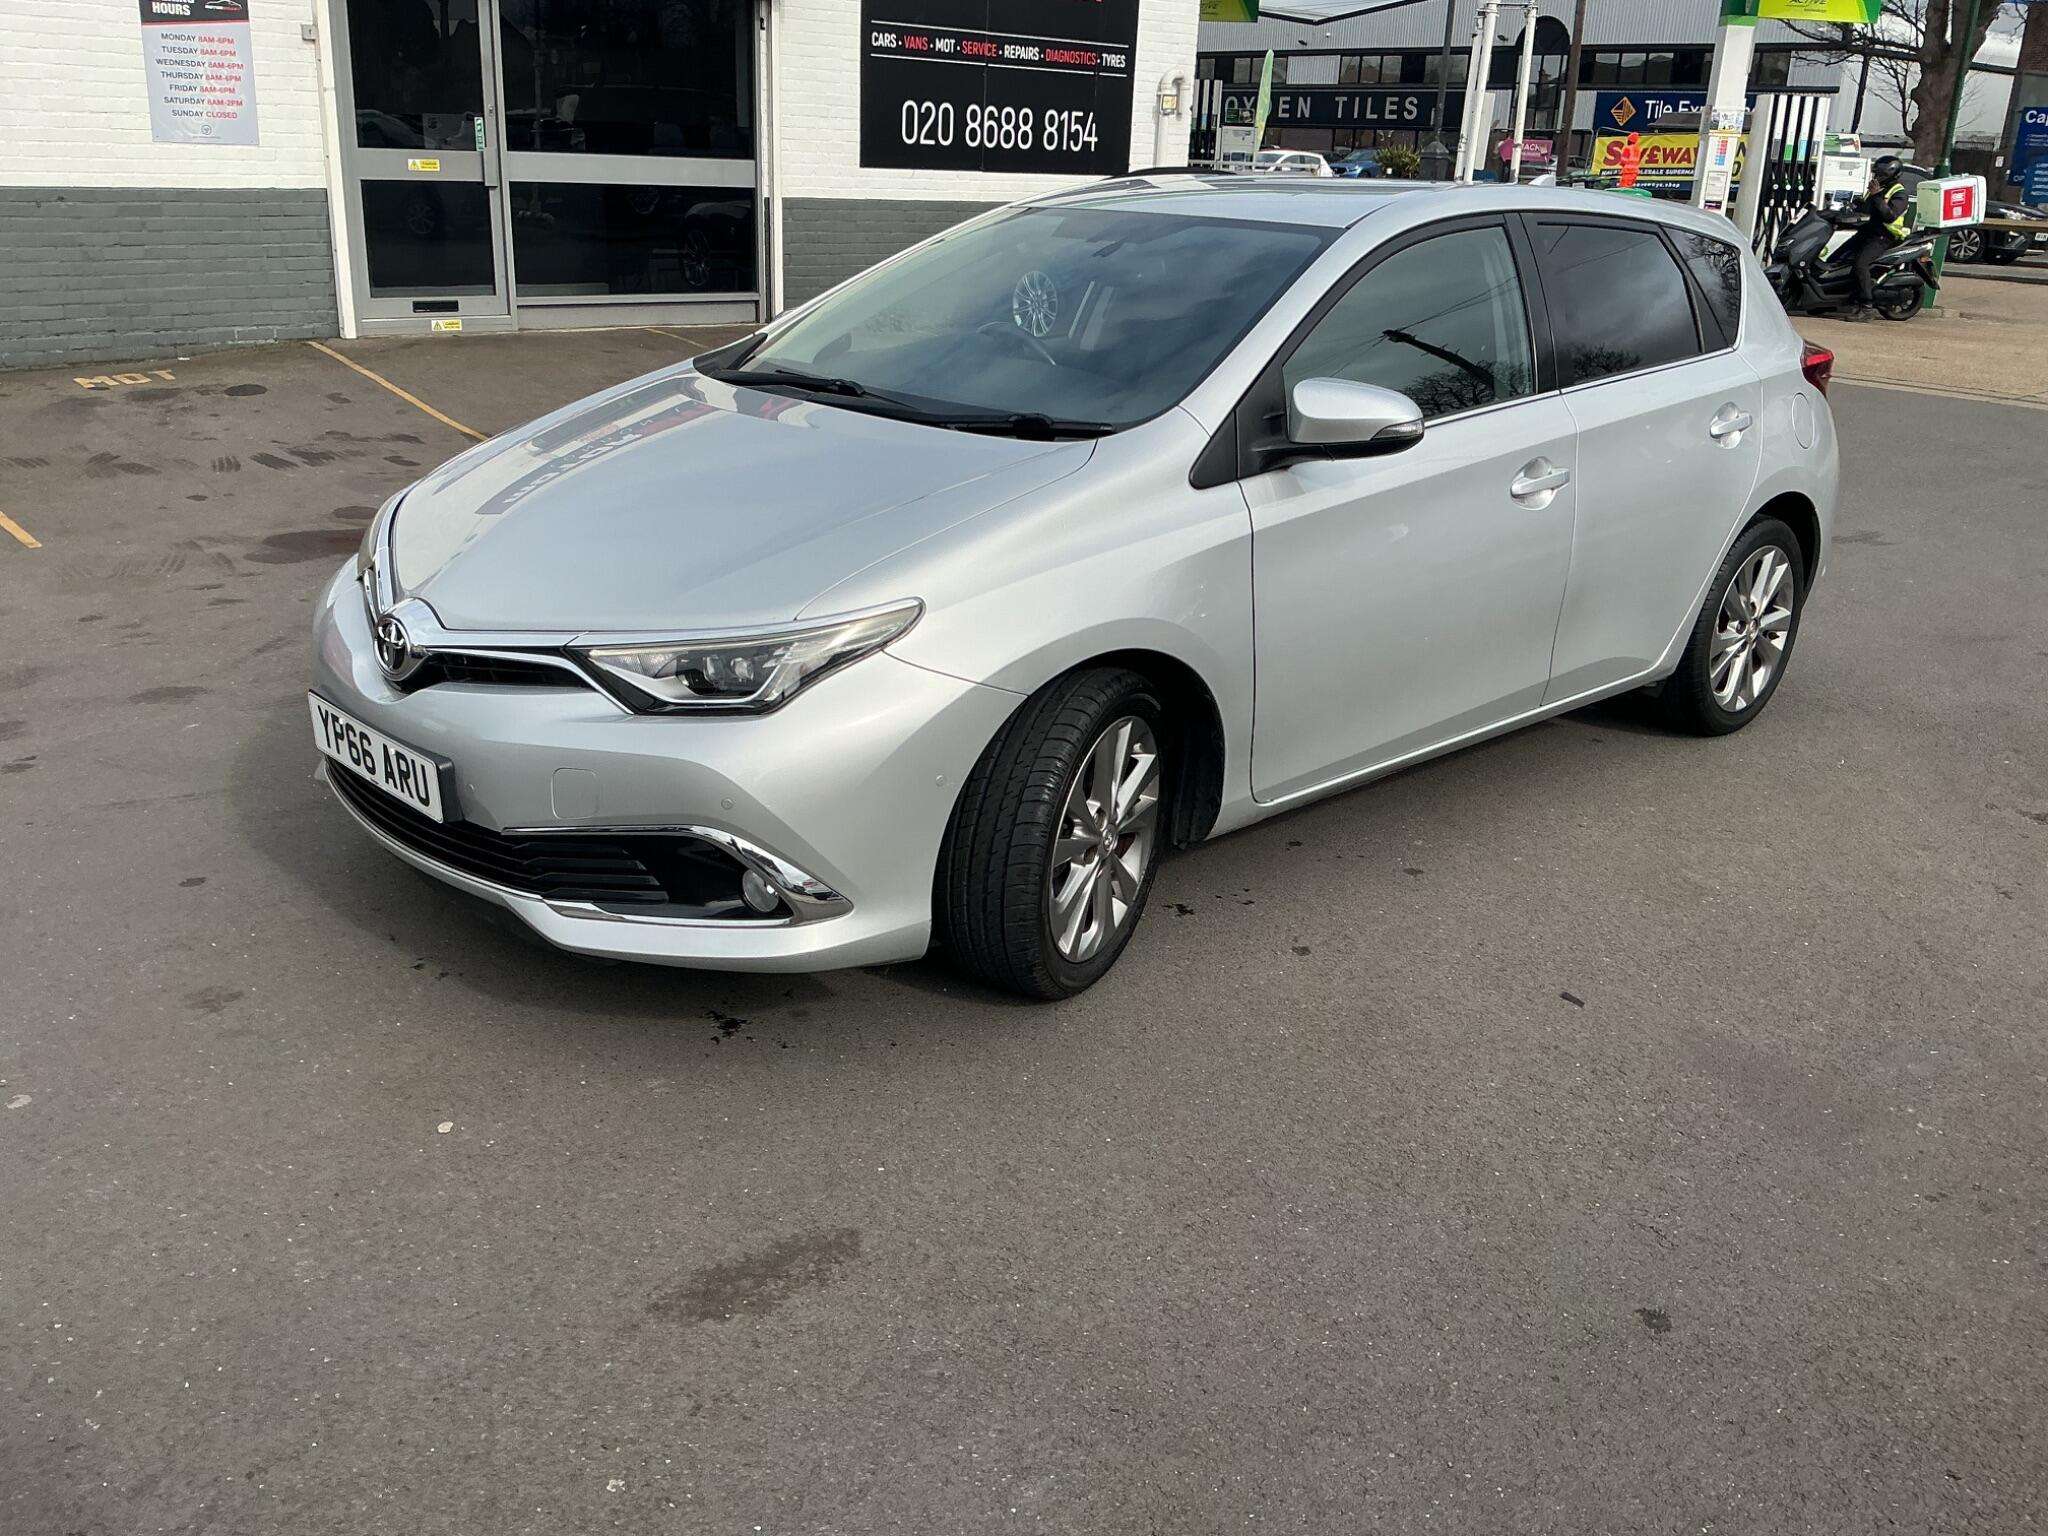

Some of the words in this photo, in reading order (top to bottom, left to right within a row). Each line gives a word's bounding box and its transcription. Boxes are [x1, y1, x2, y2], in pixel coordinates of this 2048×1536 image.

[152, 2, 191, 16] HOURS
[161, 33, 196, 42] MONDAY
[162, 46, 198, 55] TUESDAY
[871, 32, 896, 48] CARS
[904, 35, 928, 50] VANS
[935, 38, 956, 52] MOT
[962, 40, 998, 57] SERVICE
[1004, 45, 1040, 60] REPAIRS
[1045, 48, 1096, 65] DIAGNOSTICS
[1102, 53, 1126, 68] TYRES
[155, 58, 206, 67] WEDNESDAY
[161, 71, 203, 79] THURSDAY
[169, 84, 198, 92] FRIDAY
[163, 96, 205, 105] SATURDAY
[172, 109, 204, 117] SUNDAY
[206, 111, 238, 119] CLOSED
[1335, 96, 1418, 120] TILES
[1645, 100, 1672, 119] Tile
[901, 100, 954, 146] 020
[965, 104, 1033, 149] 8688
[1043, 109, 1098, 152] 8154
[73, 369, 176, 389] MOT
[317, 704, 377, 776] YP66
[382, 743, 431, 808] ARU
